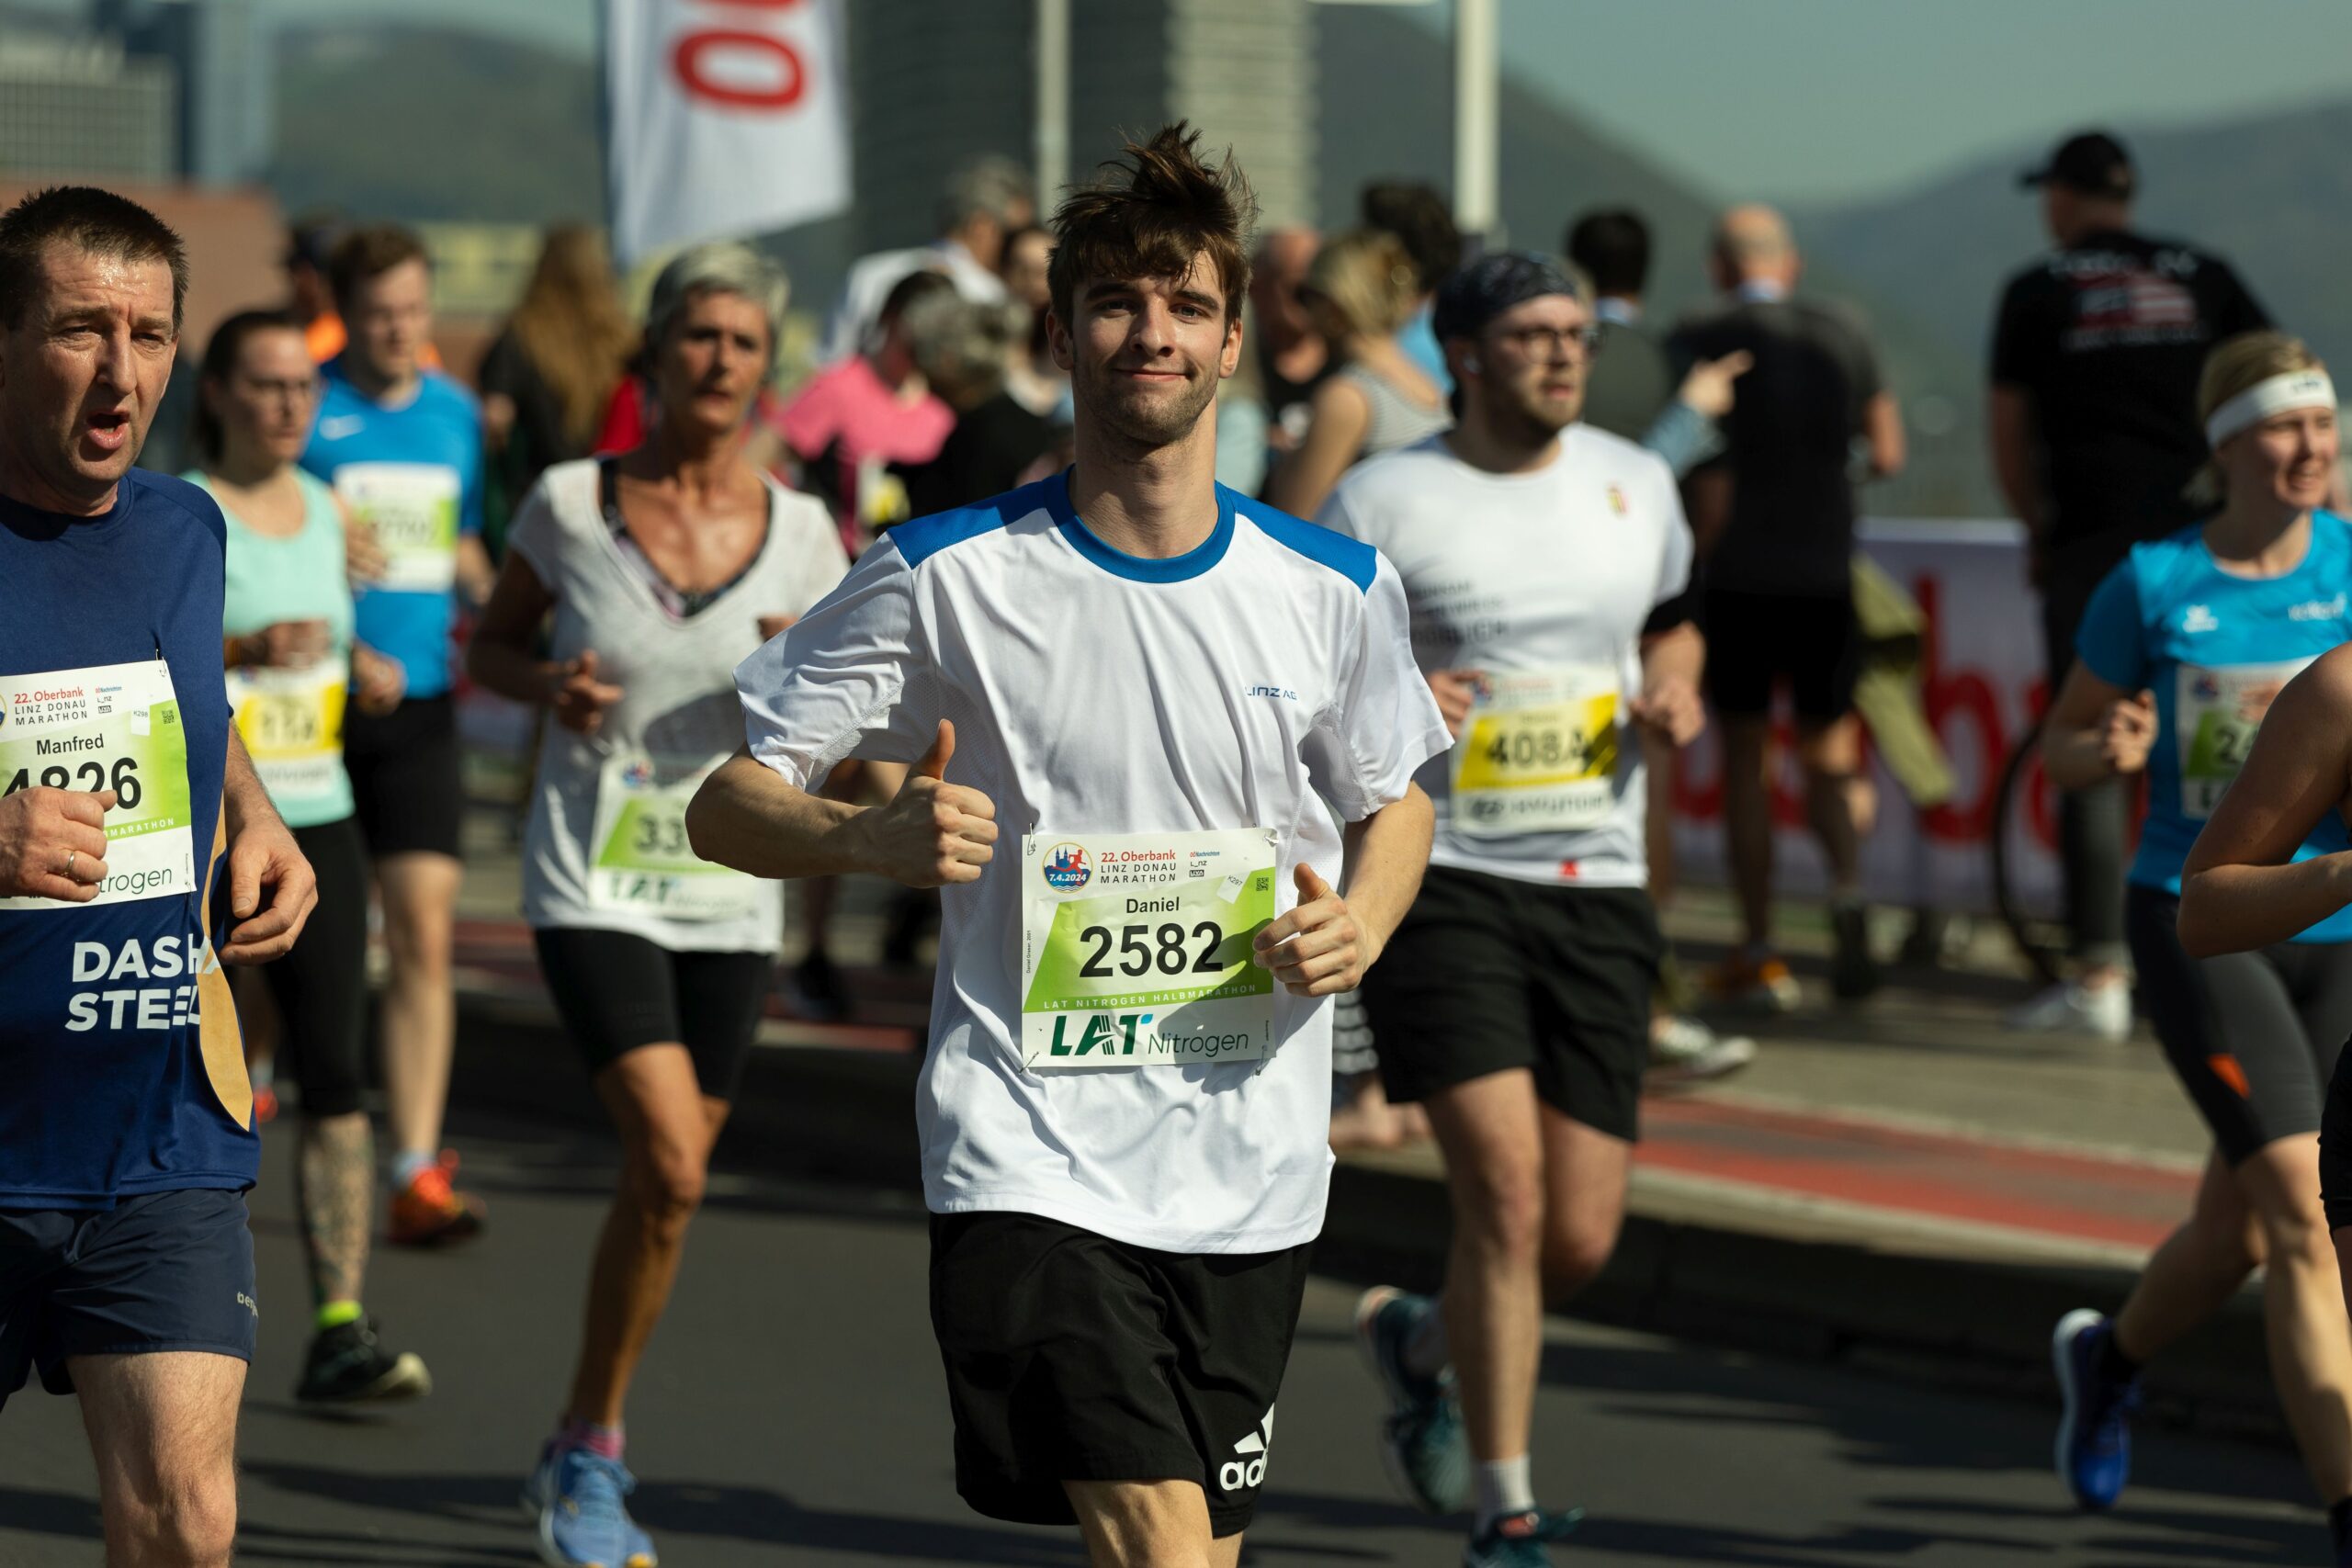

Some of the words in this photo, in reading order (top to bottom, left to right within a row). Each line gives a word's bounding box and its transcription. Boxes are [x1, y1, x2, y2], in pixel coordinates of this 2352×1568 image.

[15, 694, 31, 704] 22.
[34, 686, 84, 702] Oberbank
[15, 705, 41, 715] LINZ
[48, 700, 86, 711] DONAU
[16, 711, 87, 726] MARATHON
[37, 733, 104, 755] Manfred
[1101, 852, 1118, 863] 22.
[1121, 850, 1176, 862] Oberbank
[1101, 864, 1126, 873] LINZ
[1134, 863, 1176, 873] DONAU
[99, 868, 172, 895] trogen
[1049, 874, 1087, 882] 7.4.2024
[1101, 874, 1176, 884] MARATHON
[1126, 897, 1180, 913] Daniel
[1079, 921, 1223, 977] 2582
[1044, 1000, 1068, 1009] LAT
[1076, 996, 1146, 1008] NITROGEN
[1153, 985, 1256, 1002] HALBMARATHON
[1050, 1014, 1144, 1056] LAT
[1148, 1032, 1249, 1057] Nitrogen
